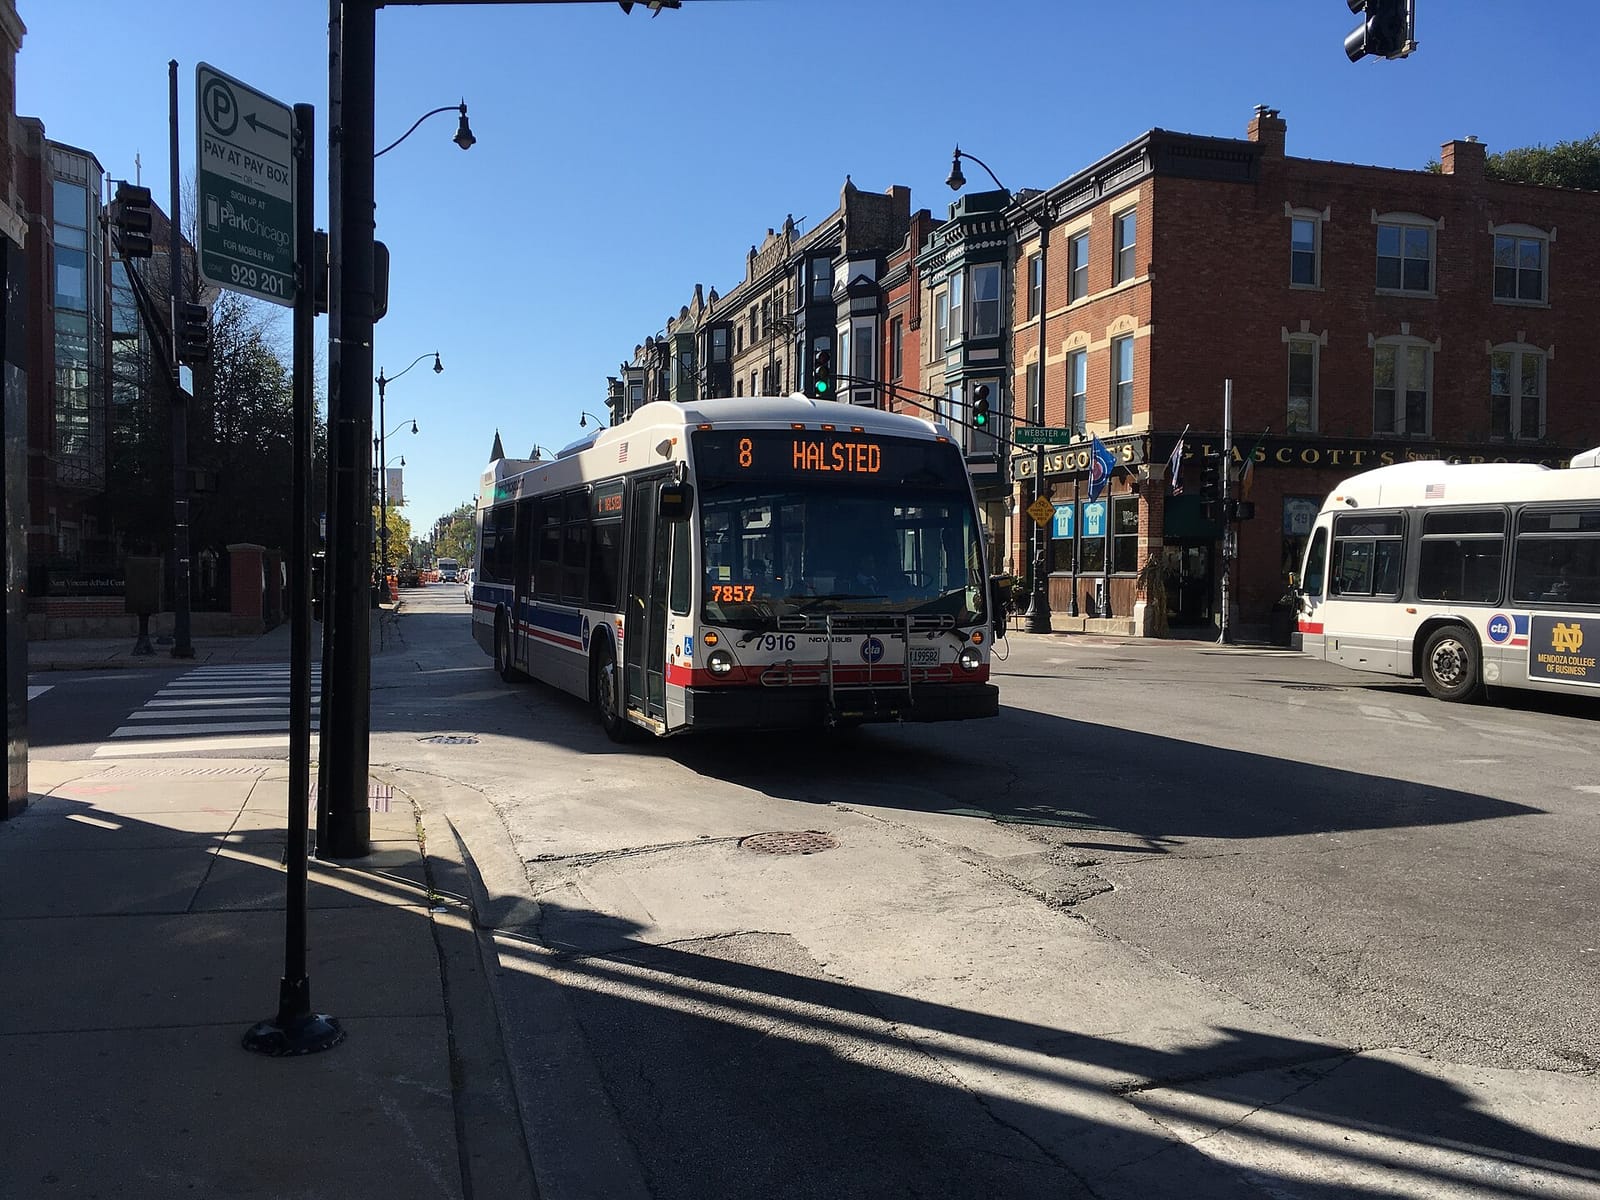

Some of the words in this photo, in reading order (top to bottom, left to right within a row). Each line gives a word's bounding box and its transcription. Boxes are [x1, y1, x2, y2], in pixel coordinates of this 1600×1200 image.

[213, 88, 231, 122] P
[204, 139, 225, 160] PAY
[227, 148, 241, 167] AT
[243, 156, 264, 176] PAY
[266, 166, 289, 186] BOX
[243, 174, 253, 185] OR
[230, 190, 247, 204] SIGN
[247, 197, 257, 207] UP
[258, 201, 266, 210] AT
[220, 207, 290, 247] ParkChicago
[223, 239, 237, 251] FOR
[237, 244, 263, 259] MOBILE
[263, 251, 275, 263] PAY
[231, 263, 257, 288] 929
[261, 272, 284, 296] 201
[1024, 429, 1058, 438] WEBSTER
[739, 438, 753, 468] 8
[792, 440, 881, 473] HALSTED
[1089, 515, 1098, 526] 44
[711, 585, 755, 603] 7857
[1490, 623, 1508, 634] cta
[755, 634, 796, 651] 7916
[864, 645, 881, 655] cta
[1537, 653, 1568, 666] MENDOZA
[1568, 657, 1597, 668] COLLEGE
[1546, 663, 1555, 673] OF
[1555, 665, 1587, 676] BUSINESS
